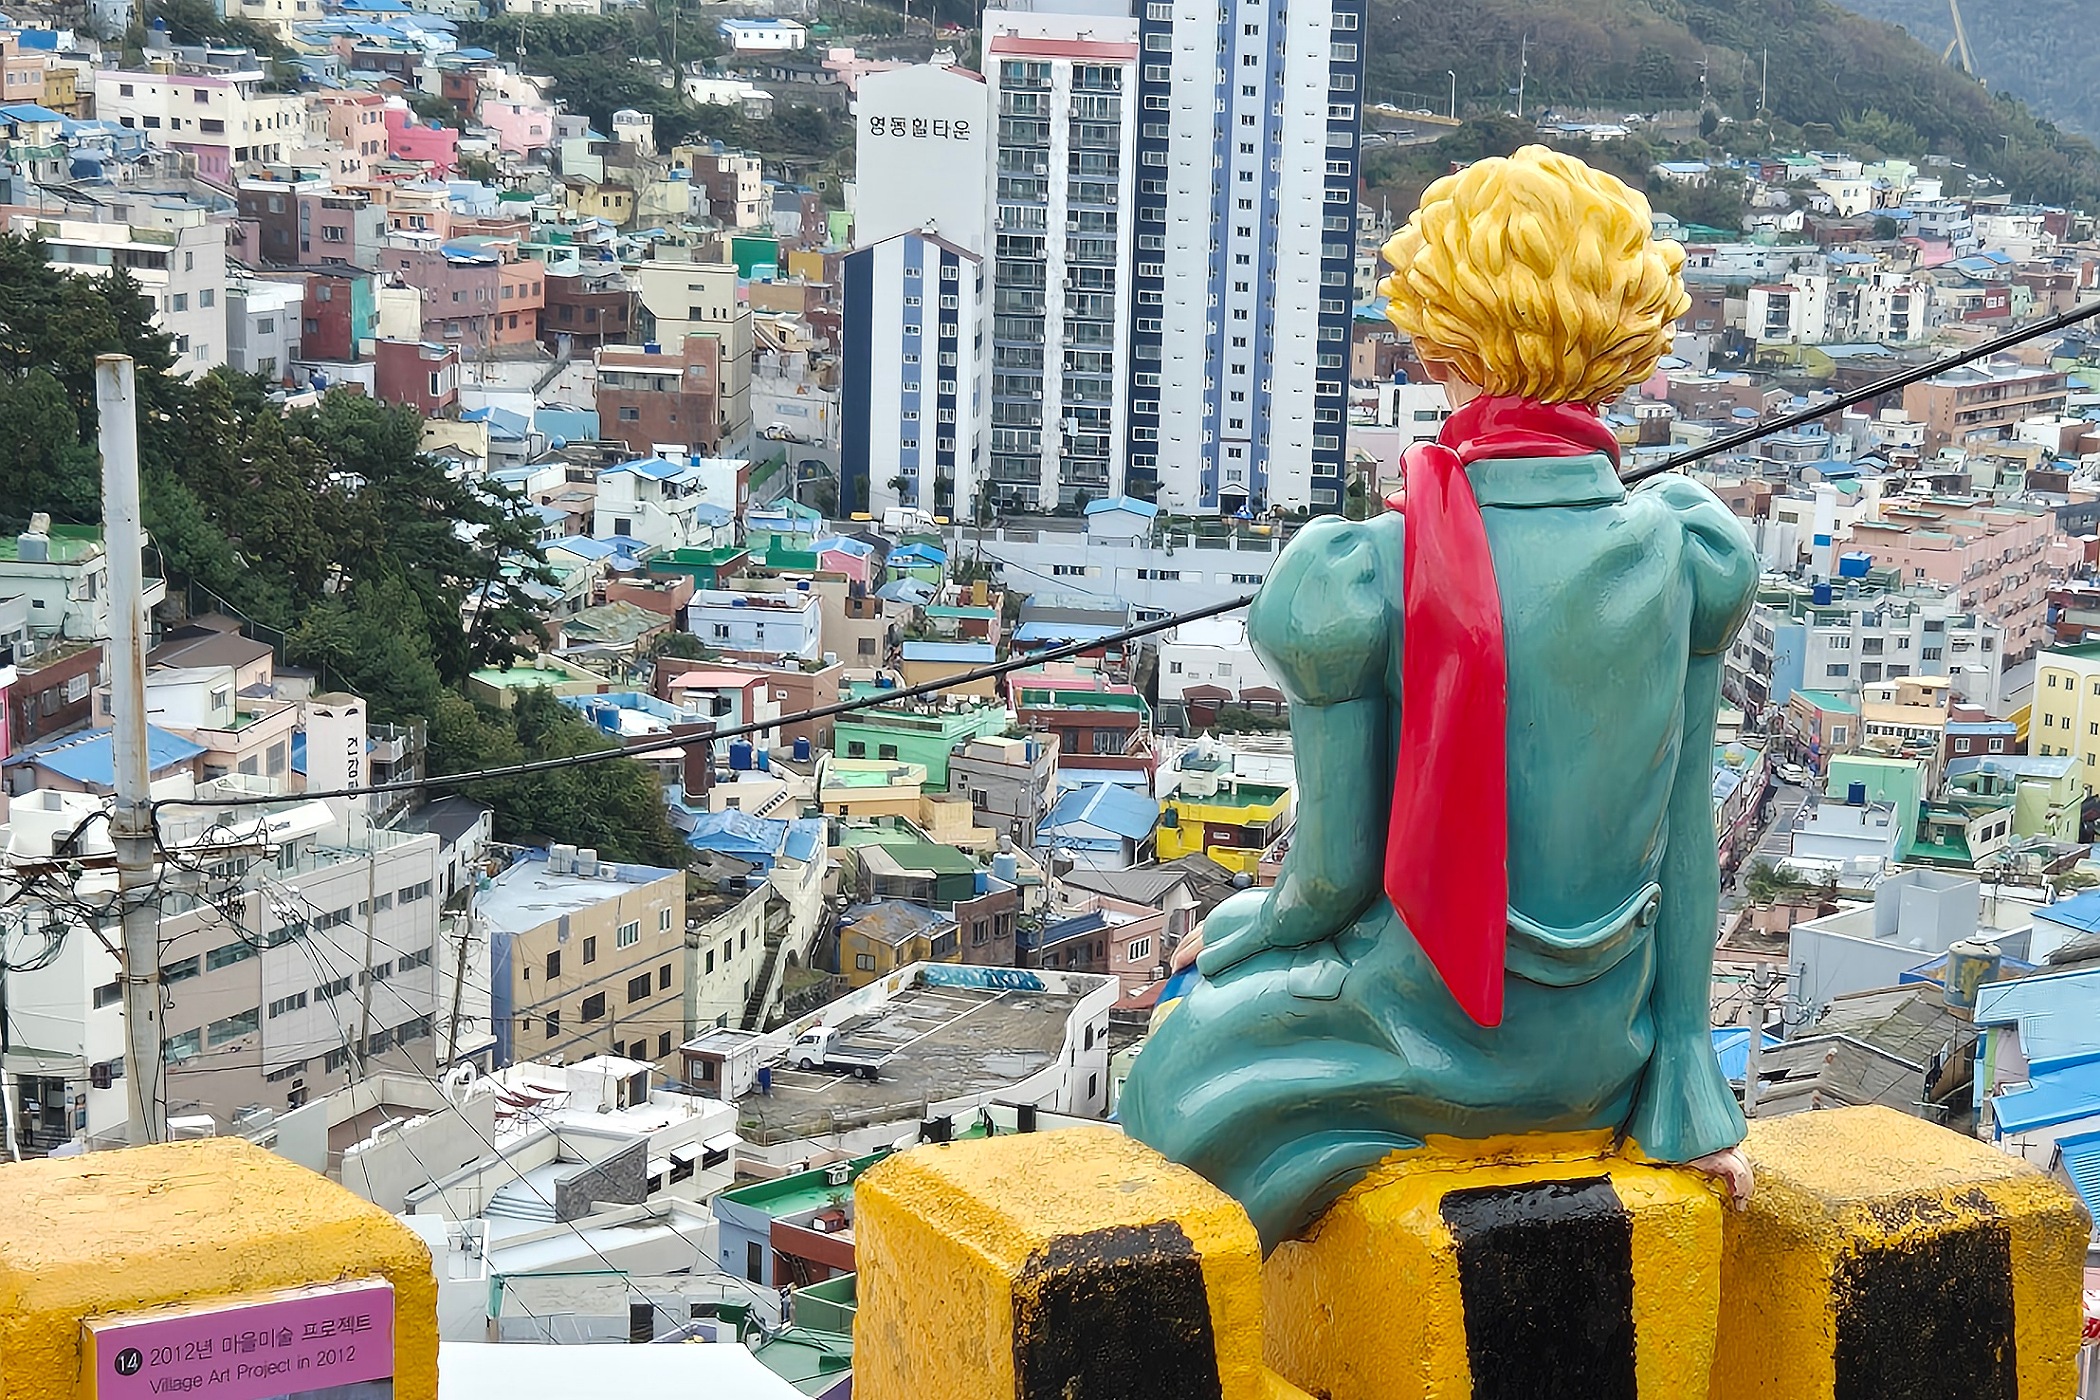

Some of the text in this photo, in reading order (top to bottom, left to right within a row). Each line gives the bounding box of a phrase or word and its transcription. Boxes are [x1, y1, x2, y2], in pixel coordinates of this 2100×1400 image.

[119, 1314, 372, 1373] 14 2012년 마을미술 프로젝트
[149, 1345, 356, 1394] Village Art Project in 2012
